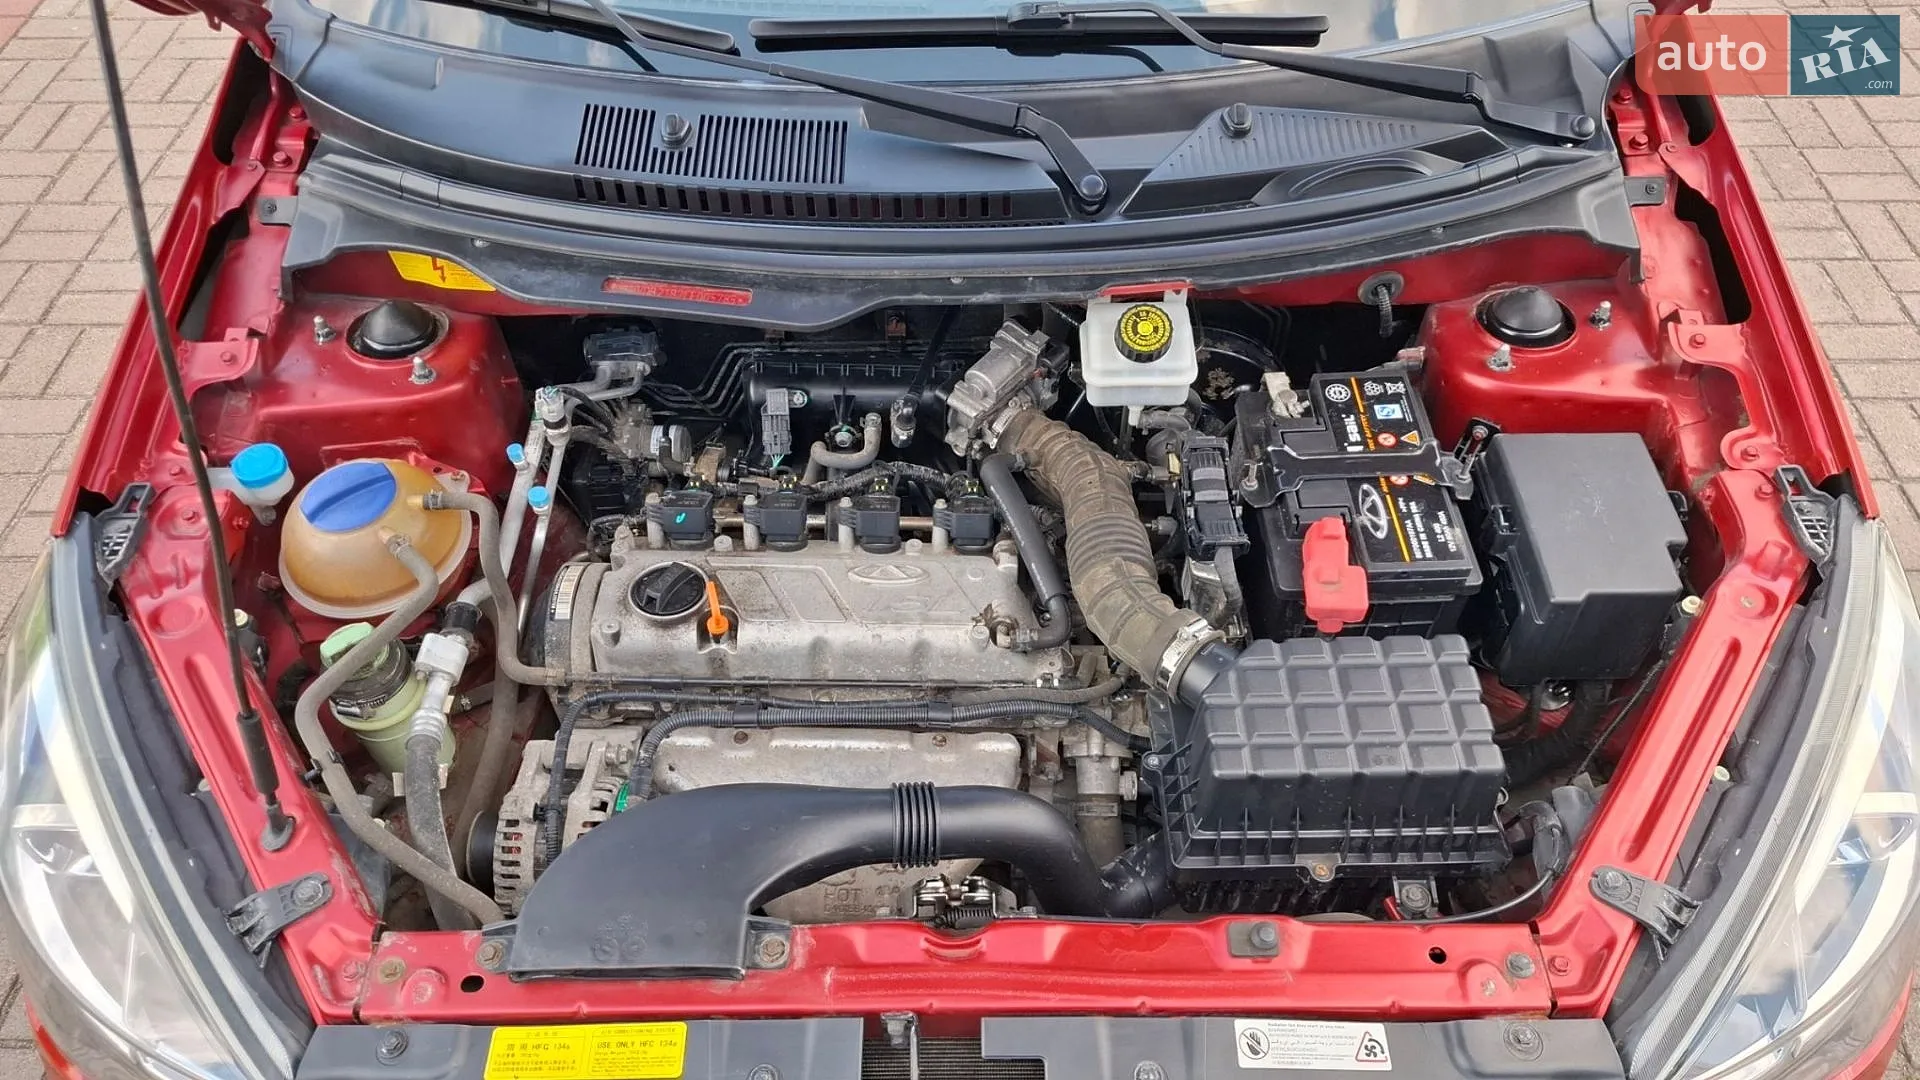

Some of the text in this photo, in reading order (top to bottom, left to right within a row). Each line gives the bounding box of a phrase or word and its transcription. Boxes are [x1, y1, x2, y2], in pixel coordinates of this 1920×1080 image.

[597, 1041, 612, 1049] USE
[616, 1040, 635, 1049] ONLY
[639, 1040, 654, 1048] HFC
